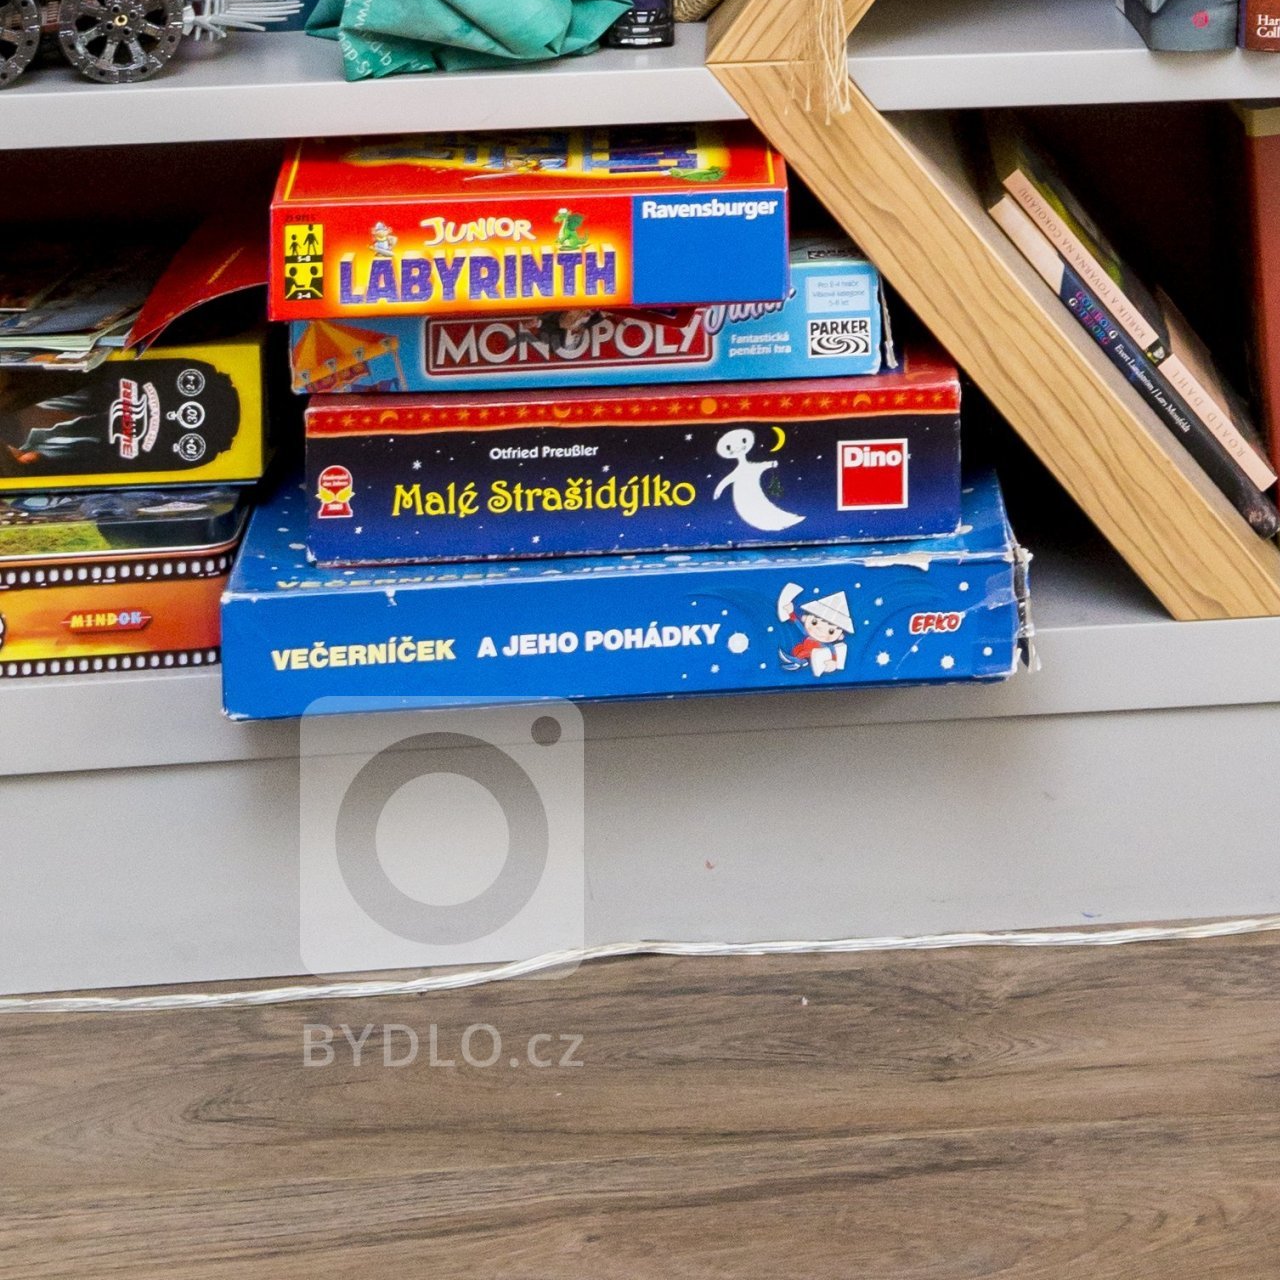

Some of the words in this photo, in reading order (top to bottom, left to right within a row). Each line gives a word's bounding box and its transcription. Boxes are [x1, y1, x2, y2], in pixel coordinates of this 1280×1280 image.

[641, 198, 778, 220] Ravensburger
[420, 217, 536, 245] JUNIOR
[338, 243, 618, 306] LABYRINTH
[488, 445, 538, 461] Otfried
[841, 447, 904, 470] Dino
[271, 635, 456, 672] VEČERNÍČEK
[477, 636, 498, 658] A
[502, 630, 579, 657] JEHO
[582, 619, 722, 653] POHÁDKY
